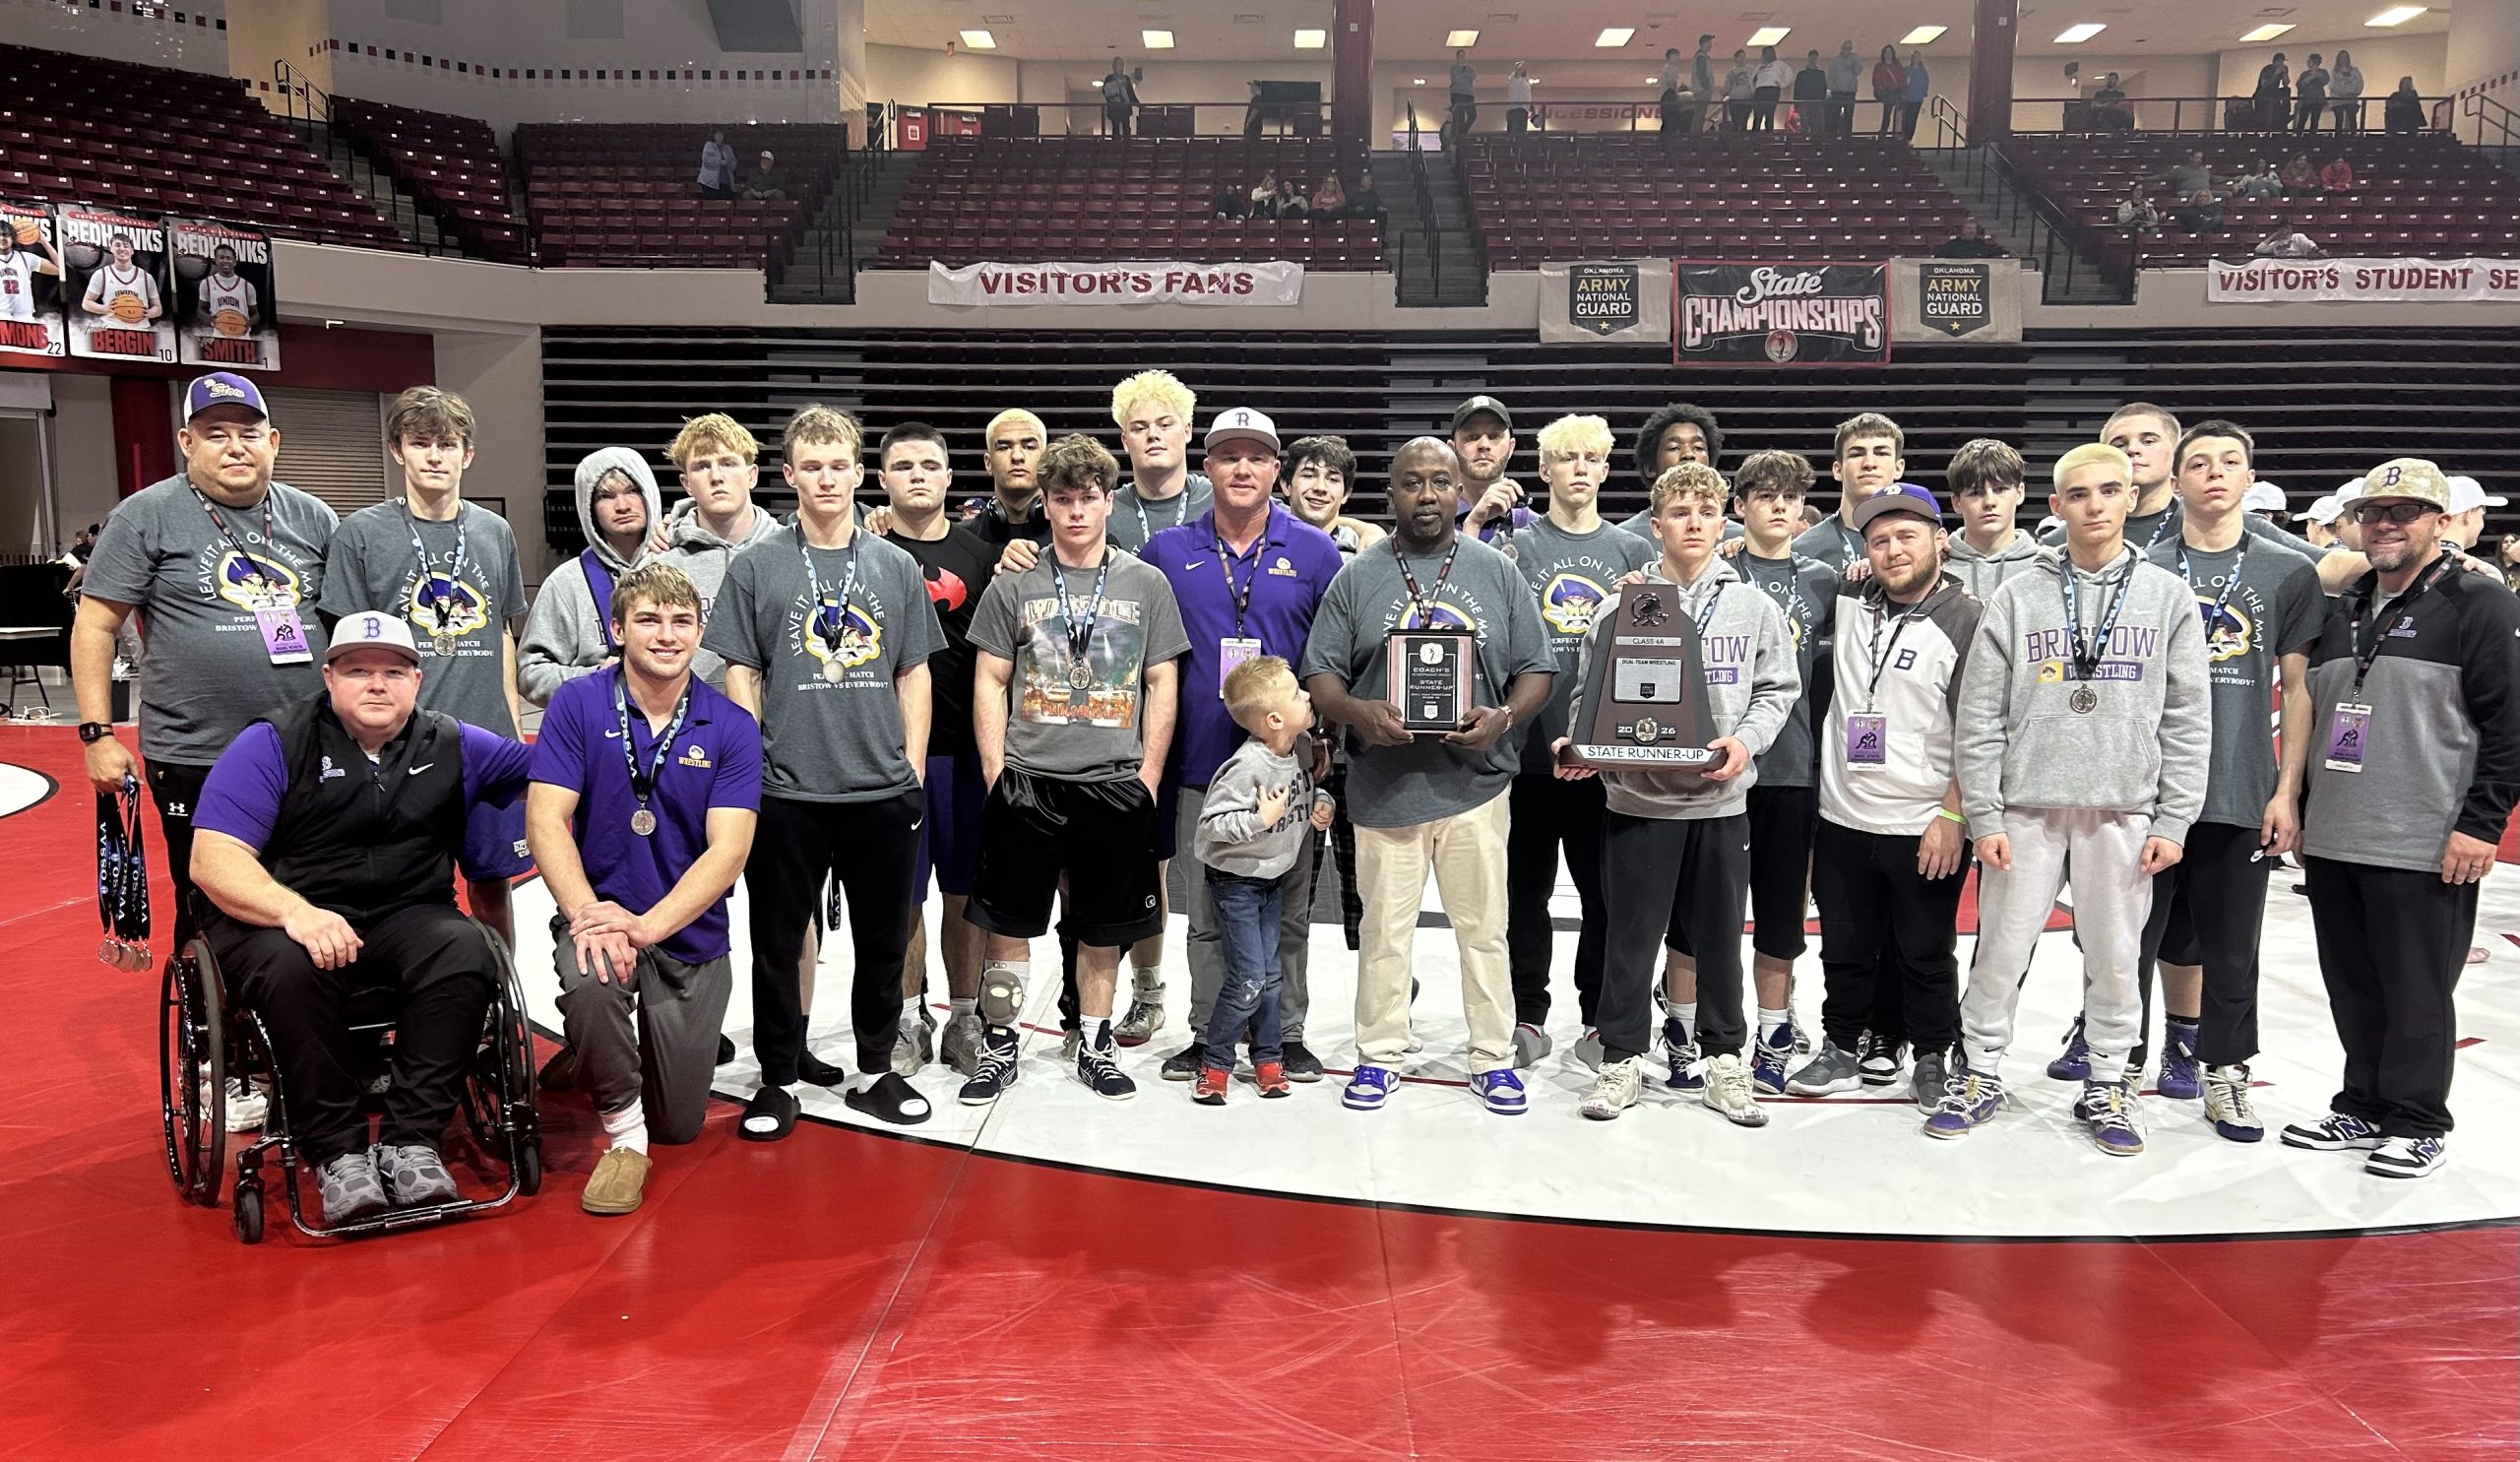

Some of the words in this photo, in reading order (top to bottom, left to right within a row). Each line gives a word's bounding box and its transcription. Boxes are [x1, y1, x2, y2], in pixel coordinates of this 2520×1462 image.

[978, 272, 1153, 294] VISITOR'S
[1165, 272, 1255, 294] FANS
[1577, 278, 1630, 291] ARMY
[1736, 267, 1823, 304] State
[1927, 279, 1982, 292] ARMY
[2219, 268, 2340, 291] VISITOR'S
[2355, 268, 2474, 290] STUDENT
[1576, 292, 1632, 302] NATIONAL
[1926, 292, 1983, 302] NATIONAL
[1575, 302, 1632, 315] GUARD
[1926, 302, 1984, 315] GUARD
[1684, 294, 1883, 348] CHAMPIONSHIPS
[46, 341, 62, 355] 22
[93, 329, 156, 356] BERGIN
[204, 338, 257, 364] SMITH
[158, 349, 173, 362] 10
[262, 356, 269, 369] 1
[2383, 467, 2402, 486] B
[204, 543, 220, 559] IT
[277, 543, 304, 568] THE
[198, 554, 218, 602] LEAVE
[1268, 567, 1298, 578] WRESTLING
[1537, 567, 1550, 582] IT
[1552, 556, 1576, 573] ALL
[1579, 555, 1604, 571] ON
[1604, 566, 1619, 586] TH
[398, 584, 412, 622] EAVE
[406, 569, 417, 582] IT
[472, 562, 490, 591] THE
[794, 594, 810, 608] IT
[2241, 586, 2265, 615] THE
[868, 591, 886, 621] THE
[1390, 598, 1405, 611] IT
[1461, 590, 1483, 615] THE
[1794, 595, 1812, 620] THE
[363, 616, 381, 639] B
[788, 609, 804, 657] LEAVE
[1894, 648, 1918, 670] B
[1704, 669, 1733, 683] TLING
[2209, 667, 2239, 675] MATCH
[797, 681, 833, 691] BRISTOW
[845, 681, 889, 690] EVERYBODY?
[620, 716, 638, 779] OSSAA
[1588, 746, 1625, 758] STATE
[1628, 747, 1704, 760] RUNNER-UP
[678, 756, 712, 769] WRESTLING
